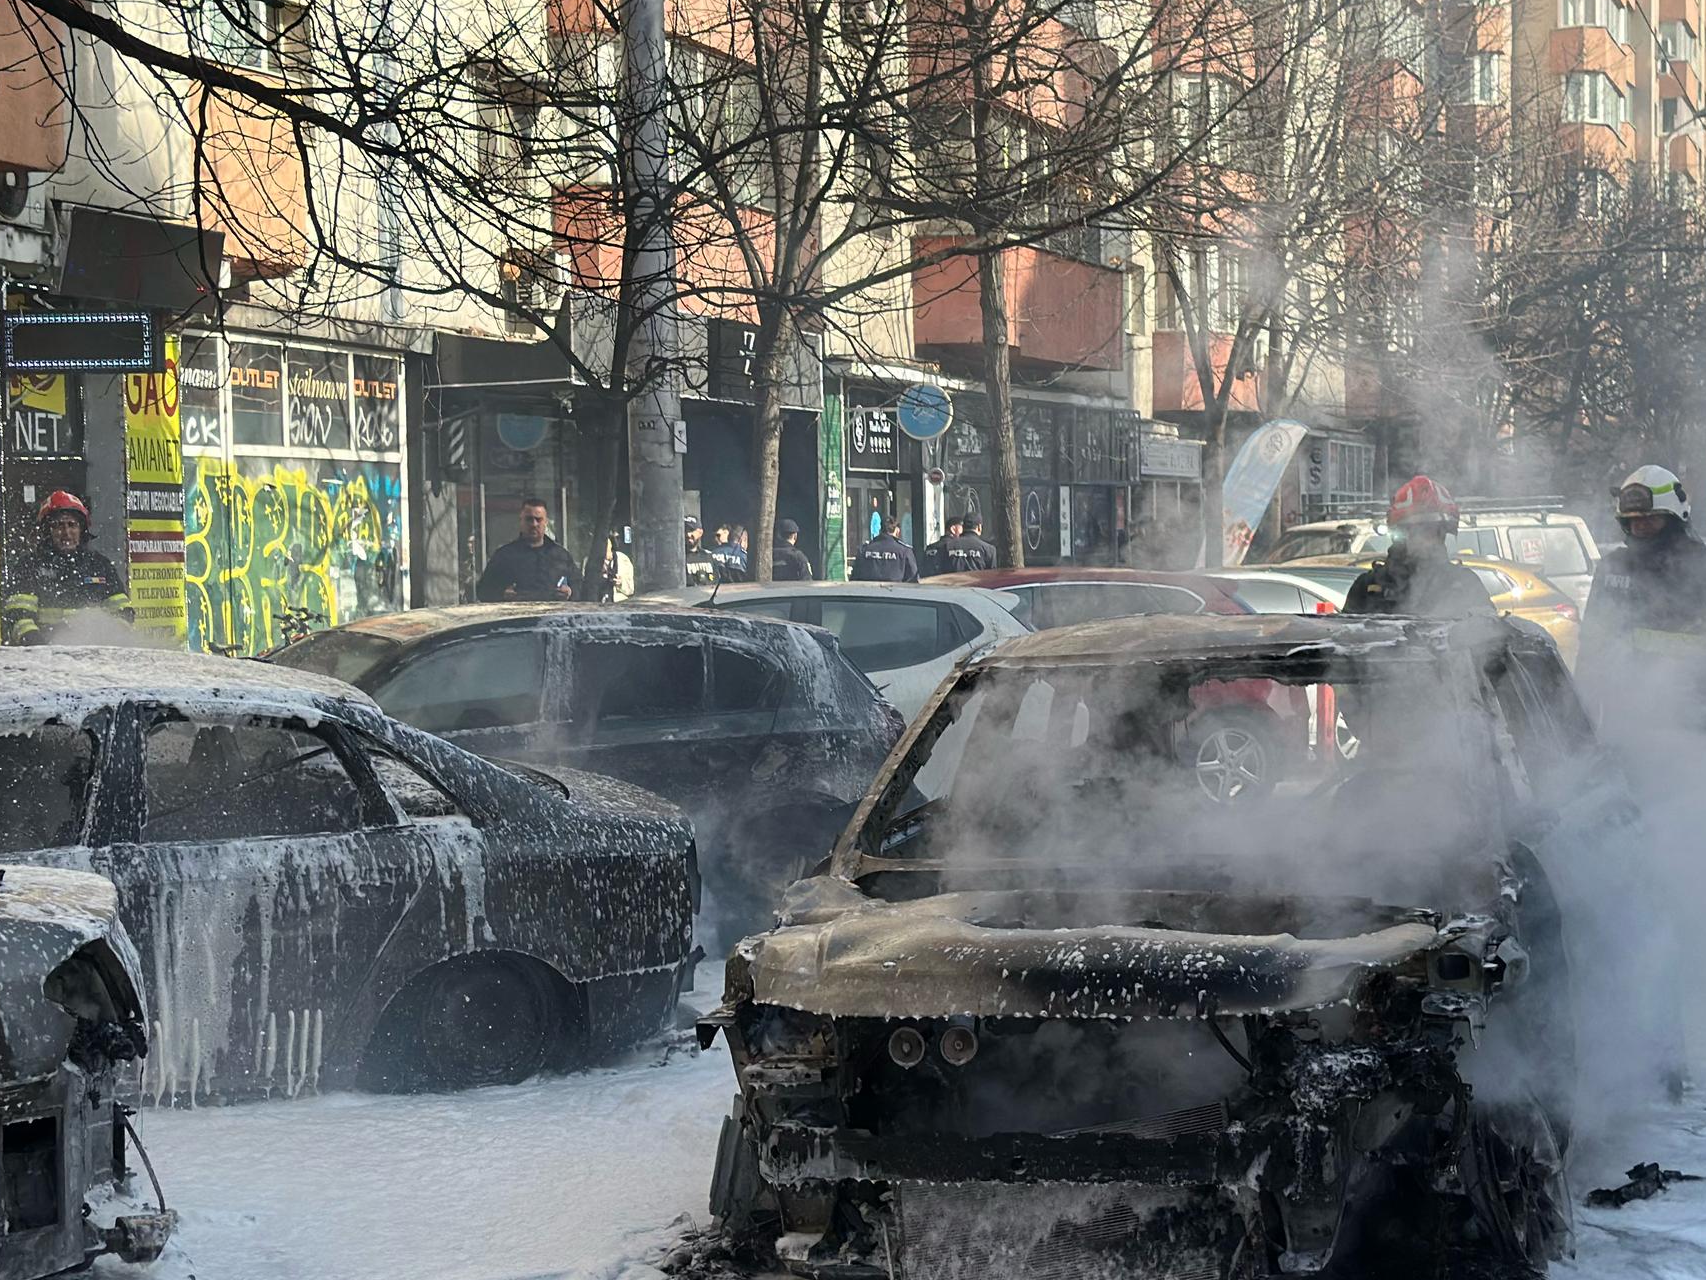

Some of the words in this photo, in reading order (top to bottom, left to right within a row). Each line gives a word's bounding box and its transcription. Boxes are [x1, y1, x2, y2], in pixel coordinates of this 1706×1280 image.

[230, 366, 280, 389] OUTLET
[288, 367, 347, 401] steilmann
[353, 378, 397, 400] OUTLET
[11, 410, 63, 453] NET
[128, 436, 180, 473] AMANET
[132, 568, 184, 580] ELECTRONICE
[136, 586, 180, 600] TELEFOANE
